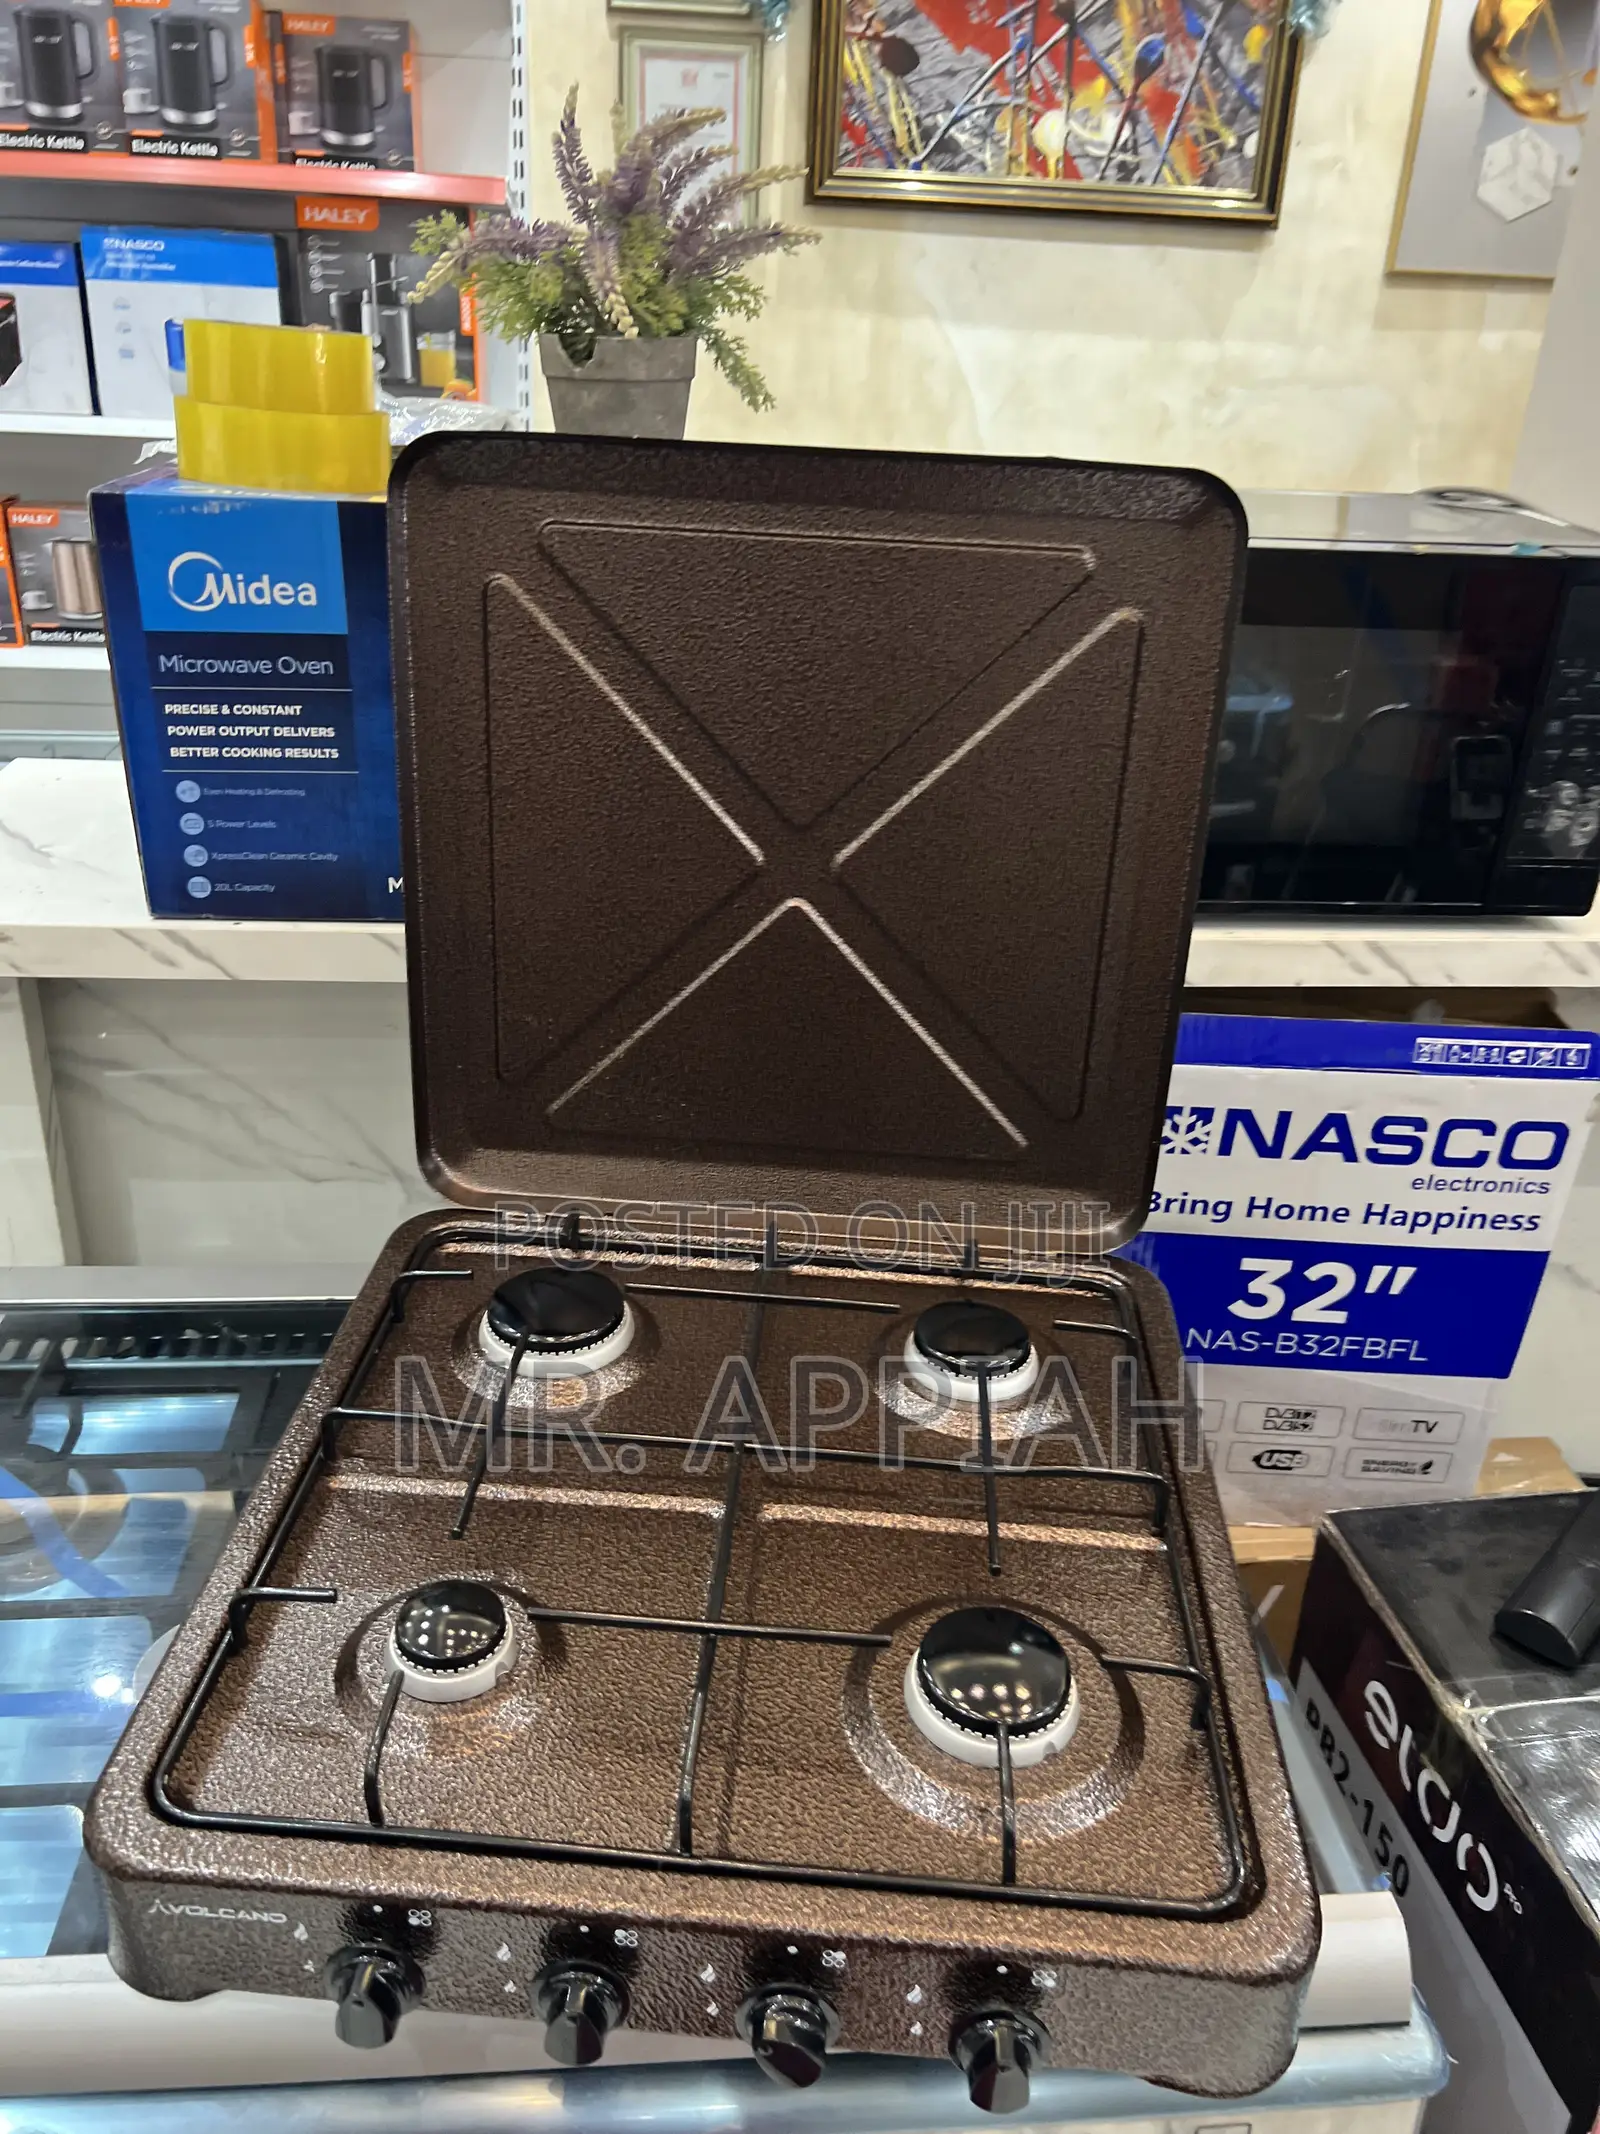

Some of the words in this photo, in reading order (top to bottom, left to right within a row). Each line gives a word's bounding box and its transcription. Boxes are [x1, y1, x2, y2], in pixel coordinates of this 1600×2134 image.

[131, 138, 179, 155] Electric
[180, 140, 218, 157] Kettle
[304, 206, 371, 224] HALEY
[12, 513, 54, 524] HALEY
[190, 569, 318, 608] Midea
[30, 630, 72, 642] Electric
[73, 631, 105, 643] Kettle
[159, 654, 273, 674] Microwave
[277, 655, 334, 675] Oven
[164, 704, 219, 715] PRECISE
[221, 704, 231, 715] &
[233, 704, 303, 716] CONSTANT
[167, 725, 216, 736] POWER
[218, 726, 270, 737] OUTPUT
[273, 727, 336, 738] DELIVERS
[170, 747, 219, 757] BETTER
[222, 747, 282, 758] COOKING
[284, 747, 340, 758] RESULTS
[225, 787, 256, 797] Heating
[216, 819, 245, 828] Power
[248, 819, 277, 828] Levels
[234, 883, 276, 893] Capacity
[1217, 1108, 1570, 1170] NASCO
[1411, 1174, 1551, 1194] electronics
[1246, 1196, 1351, 1224] Home
[1362, 1202, 1541, 1235] Happiness
[1185, 1327, 1429, 1362] NAS-B32FBFL
[1260, 1452, 1310, 1469] USB
[168, 1903, 288, 1924] VOLCANO
